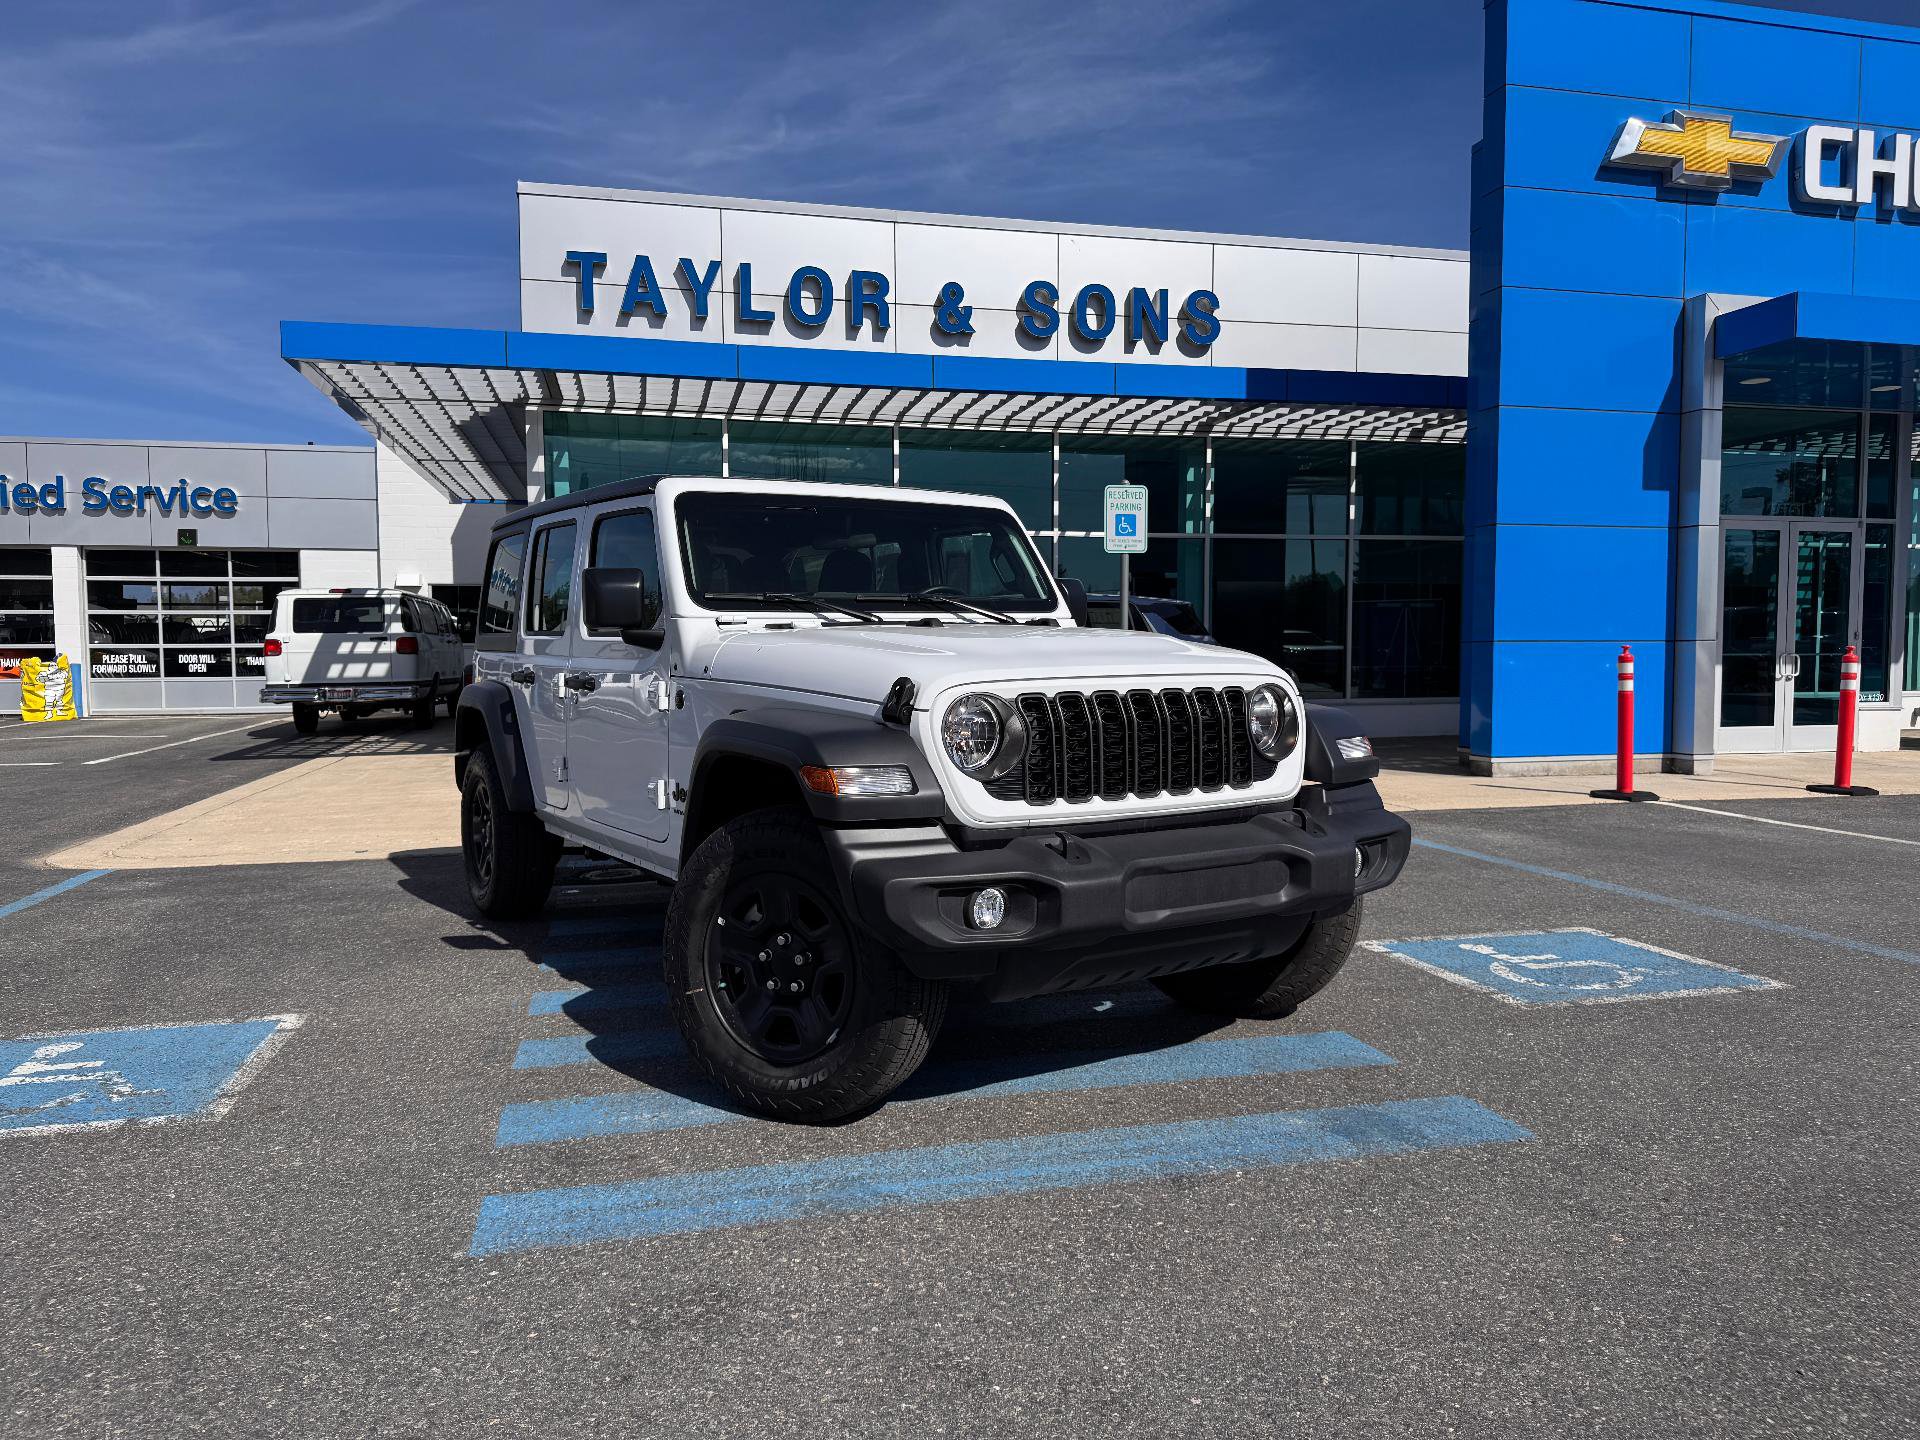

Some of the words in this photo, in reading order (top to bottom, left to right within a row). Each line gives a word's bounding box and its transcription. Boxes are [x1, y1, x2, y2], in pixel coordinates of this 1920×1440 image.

[566, 250, 891, 330] TAYLOR
[936, 281, 976, 334] &
[1022, 281, 1221, 346] SONS
[82, 476, 238, 513] Service
[1108, 490, 1144, 500] RESERVED
[1110, 502, 1142, 512] PARKING
[102, 654, 129, 664] PLEASE
[129, 654, 148, 664] PULL
[178, 654, 198, 664] DOOR
[198, 654, 216, 664] WILL
[92, 664, 128, 674] FORWARD
[188, 663, 207, 673] OPEN
